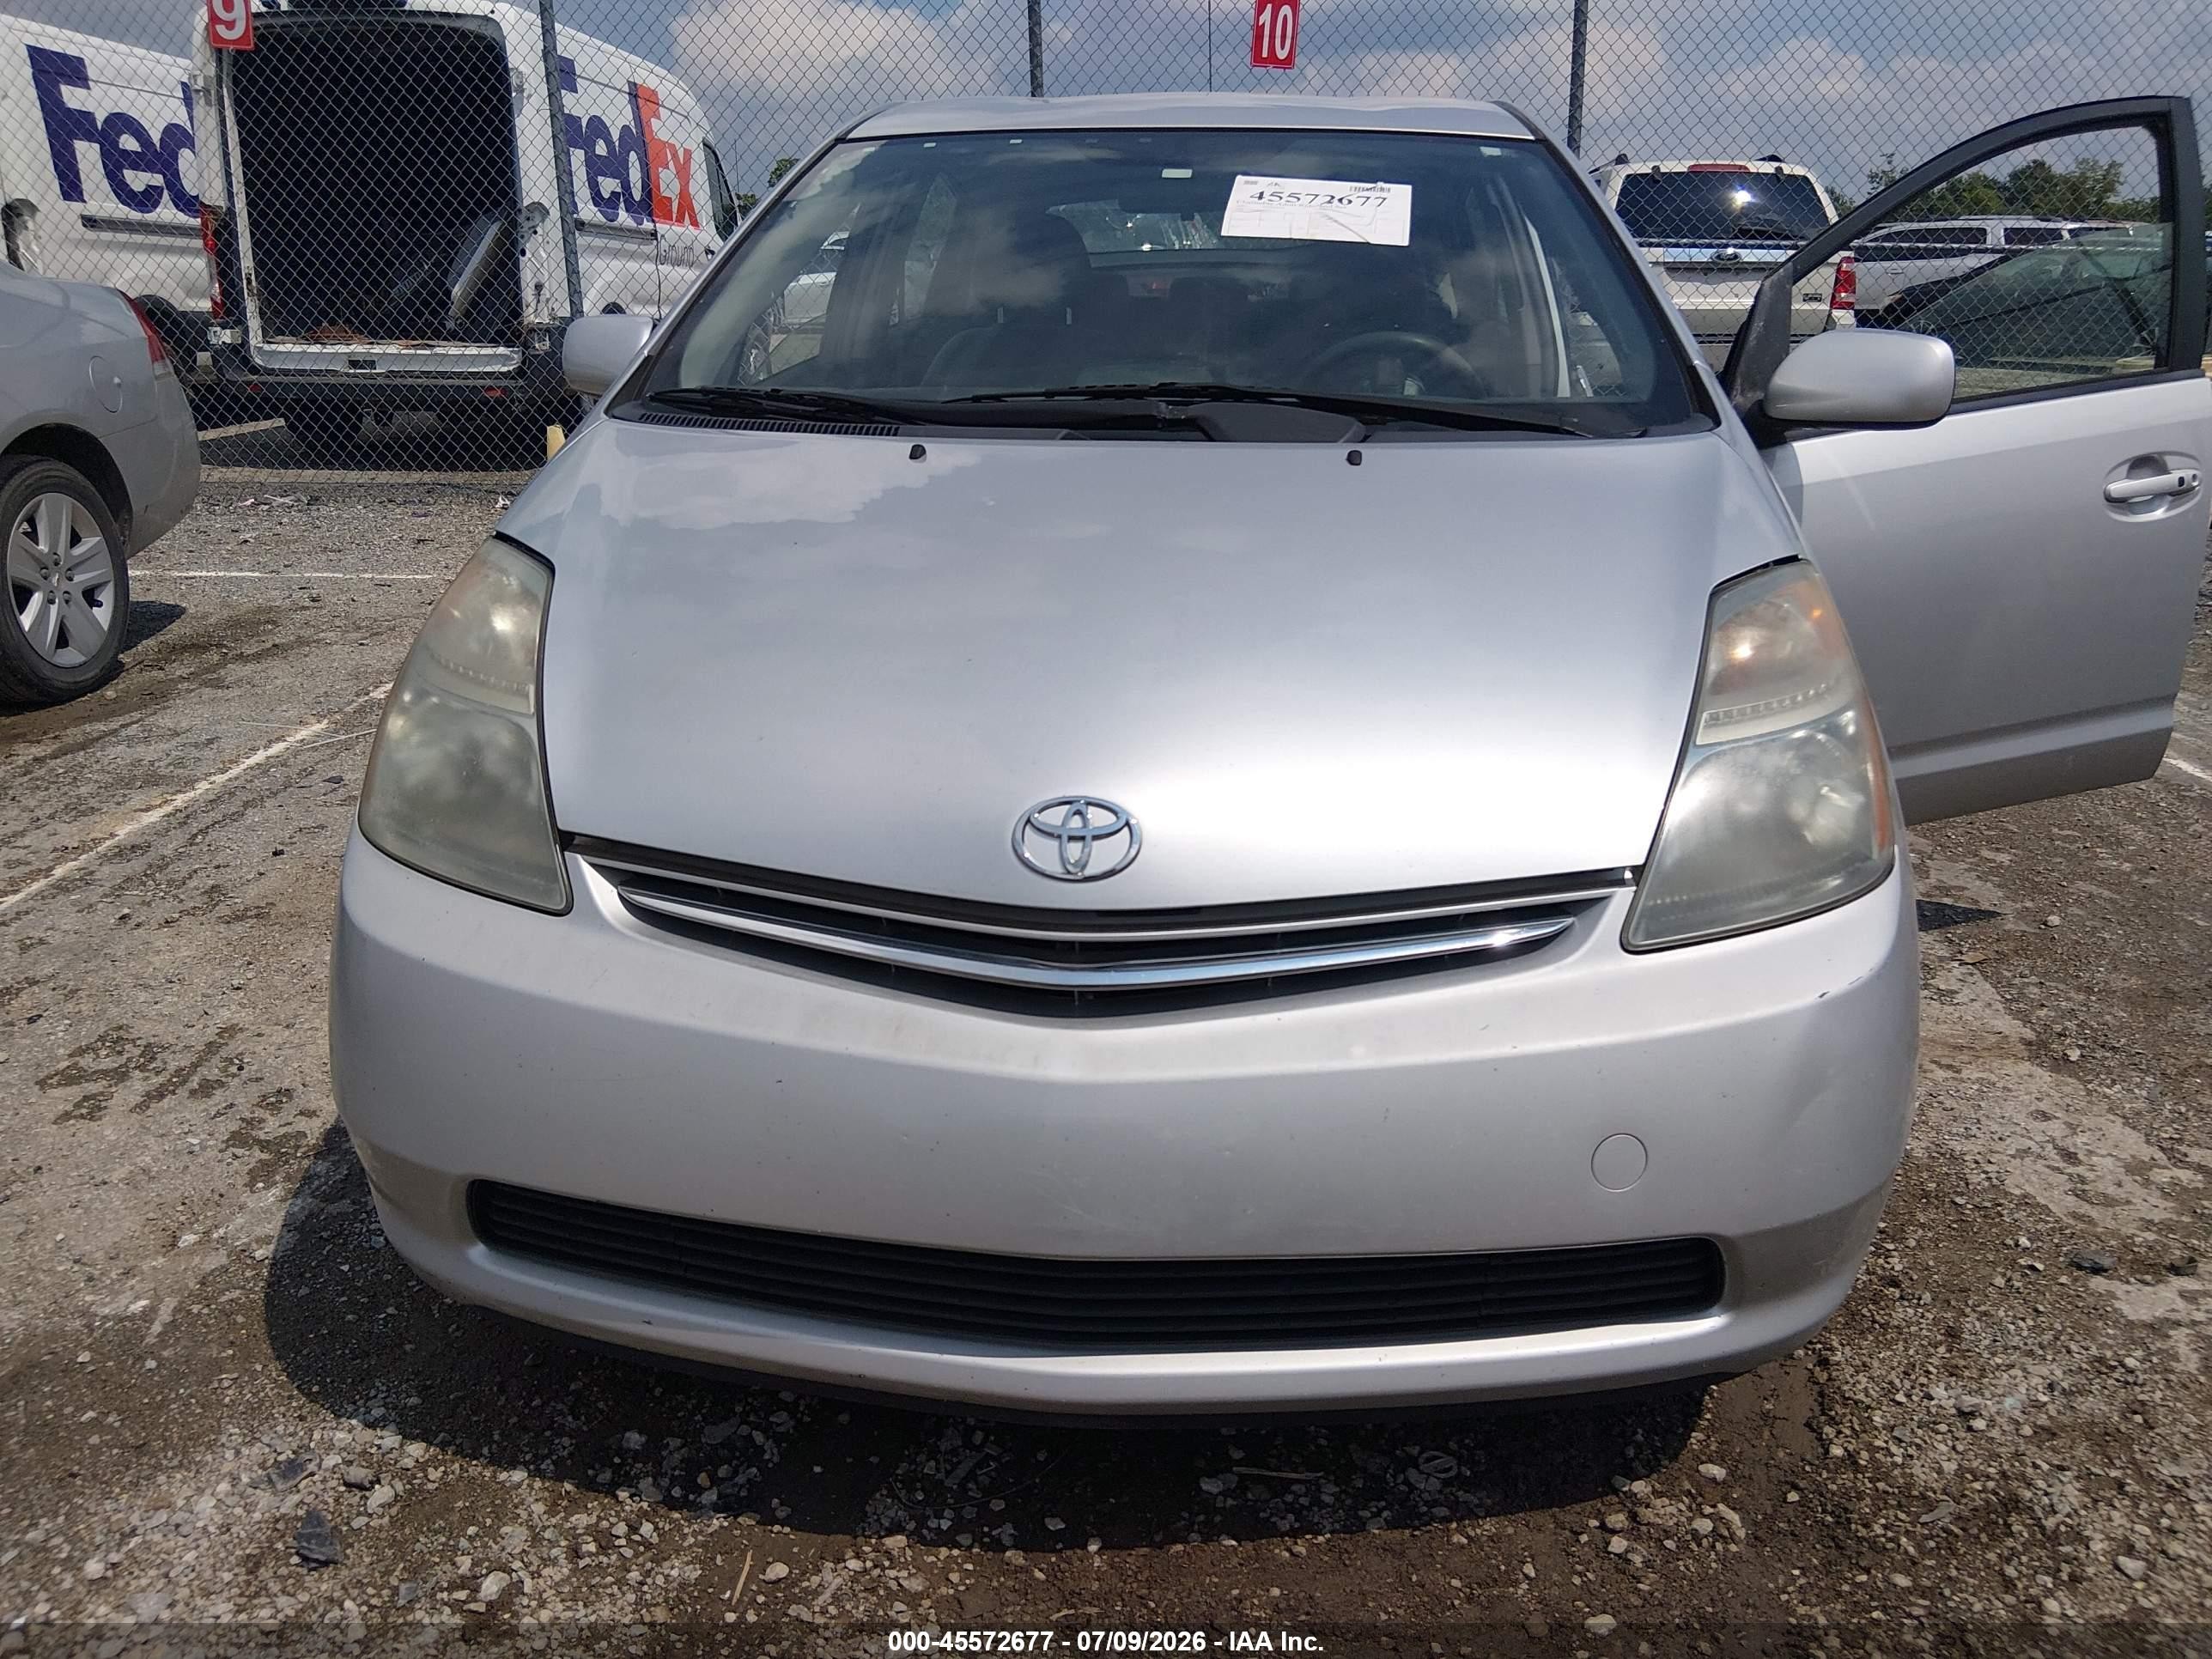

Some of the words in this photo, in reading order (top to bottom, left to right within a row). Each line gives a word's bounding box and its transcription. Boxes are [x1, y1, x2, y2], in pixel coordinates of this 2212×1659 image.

[212, 0, 246, 40] 9
[1258, 3, 1293, 60] 10
[557, 54, 701, 227] FedEx
[1249, 190, 1388, 208] 45572677
